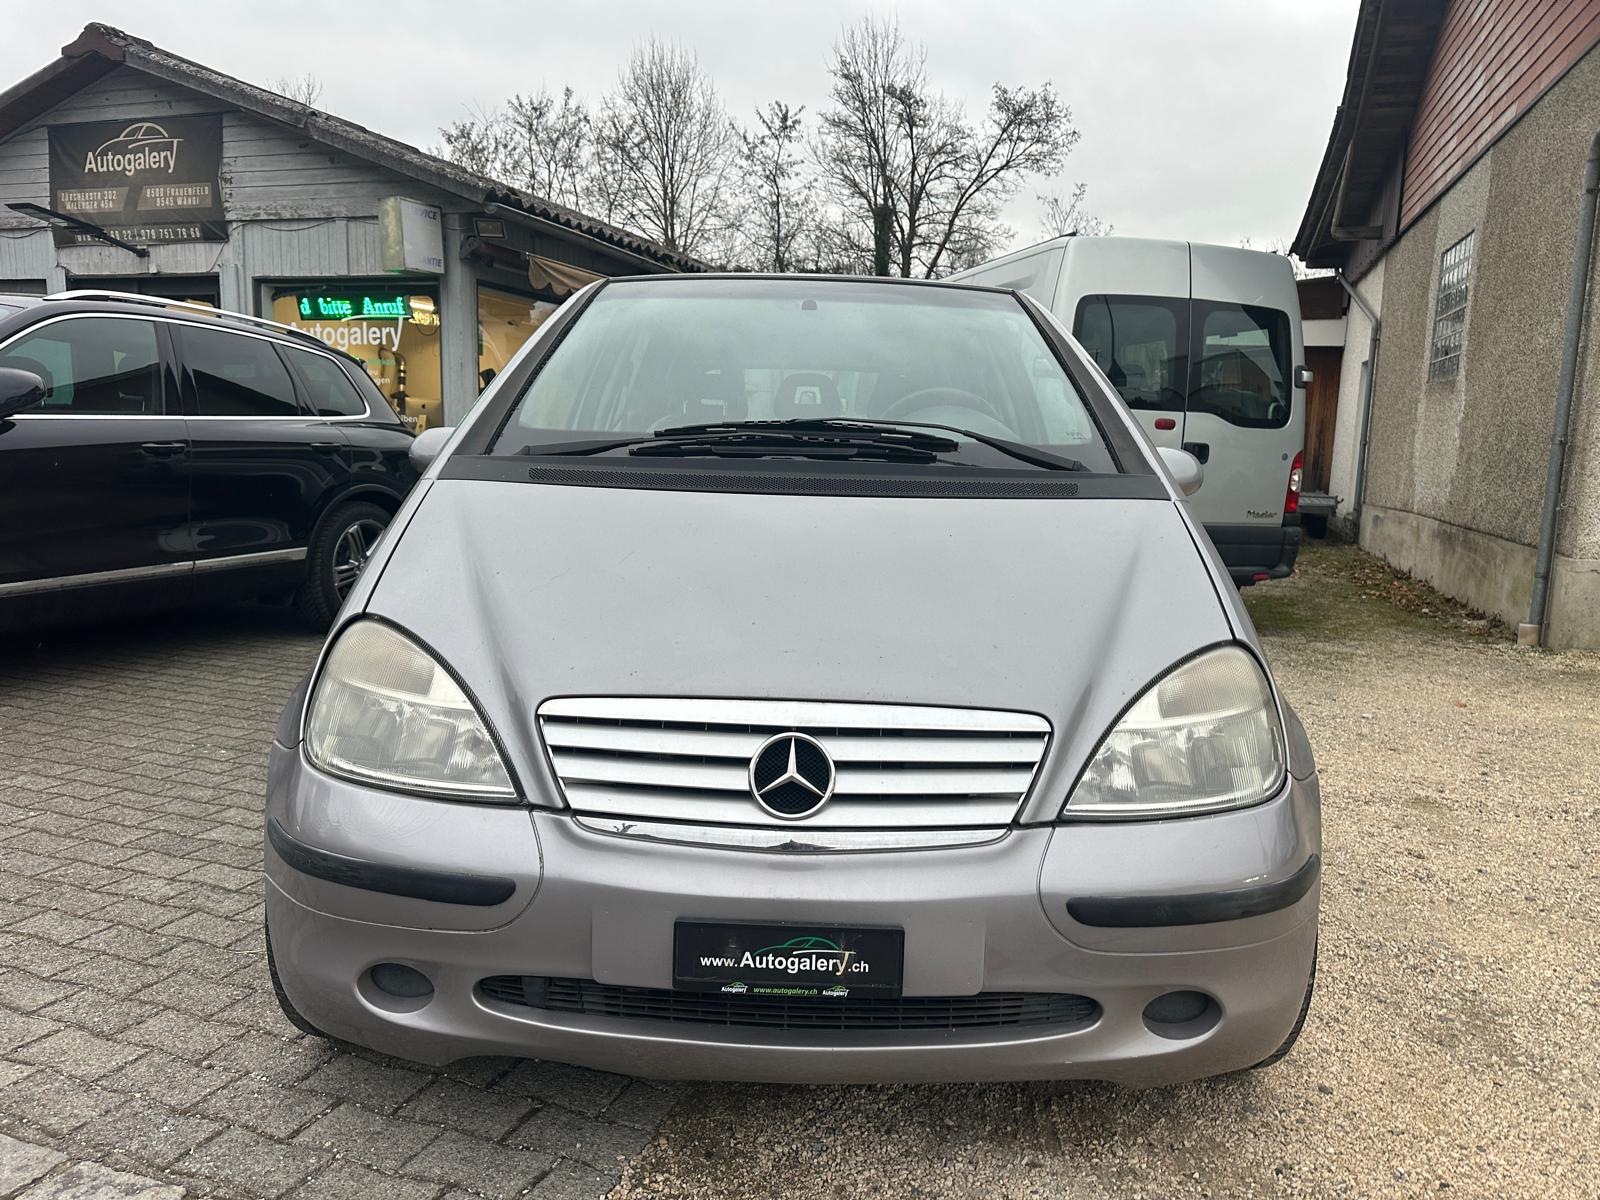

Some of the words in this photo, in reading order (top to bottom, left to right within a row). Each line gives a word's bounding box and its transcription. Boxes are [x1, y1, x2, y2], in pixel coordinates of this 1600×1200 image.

[84, 145, 178, 176] Autogalery
[318, 297, 353, 315] bitte
[363, 297, 406, 315] Anruf
[290, 317, 403, 352] togalery
[700, 950, 869, 976] www.Autogalery.ch
[721, 985, 748, 994] Autogalery
[753, 985, 818, 996] www.autogalery.ch
[822, 989, 850, 998] Autogalery
